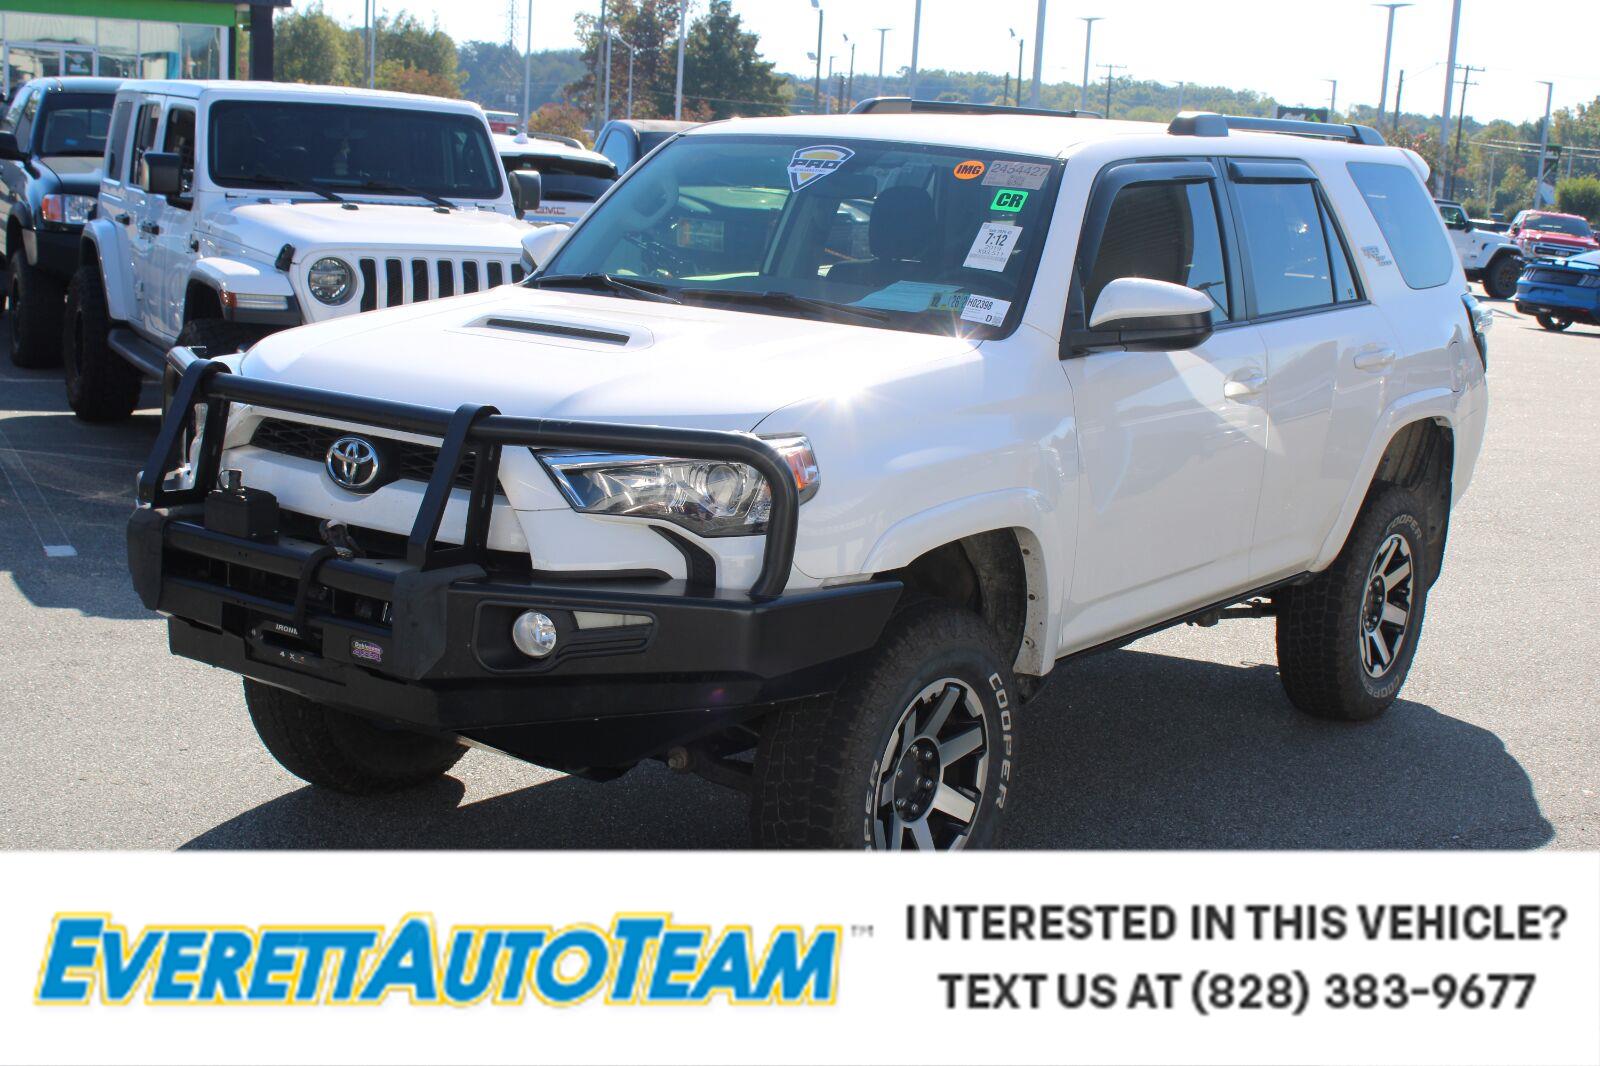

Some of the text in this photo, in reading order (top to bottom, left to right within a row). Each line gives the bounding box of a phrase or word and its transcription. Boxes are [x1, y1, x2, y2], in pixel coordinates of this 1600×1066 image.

[957, 164, 982, 175] IMG
[996, 192, 1024, 208] CR
[985, 232, 1008, 247] 7:12
[1385, 513, 1423, 541] COOPER
[988, 672, 1012, 809] COOPER
